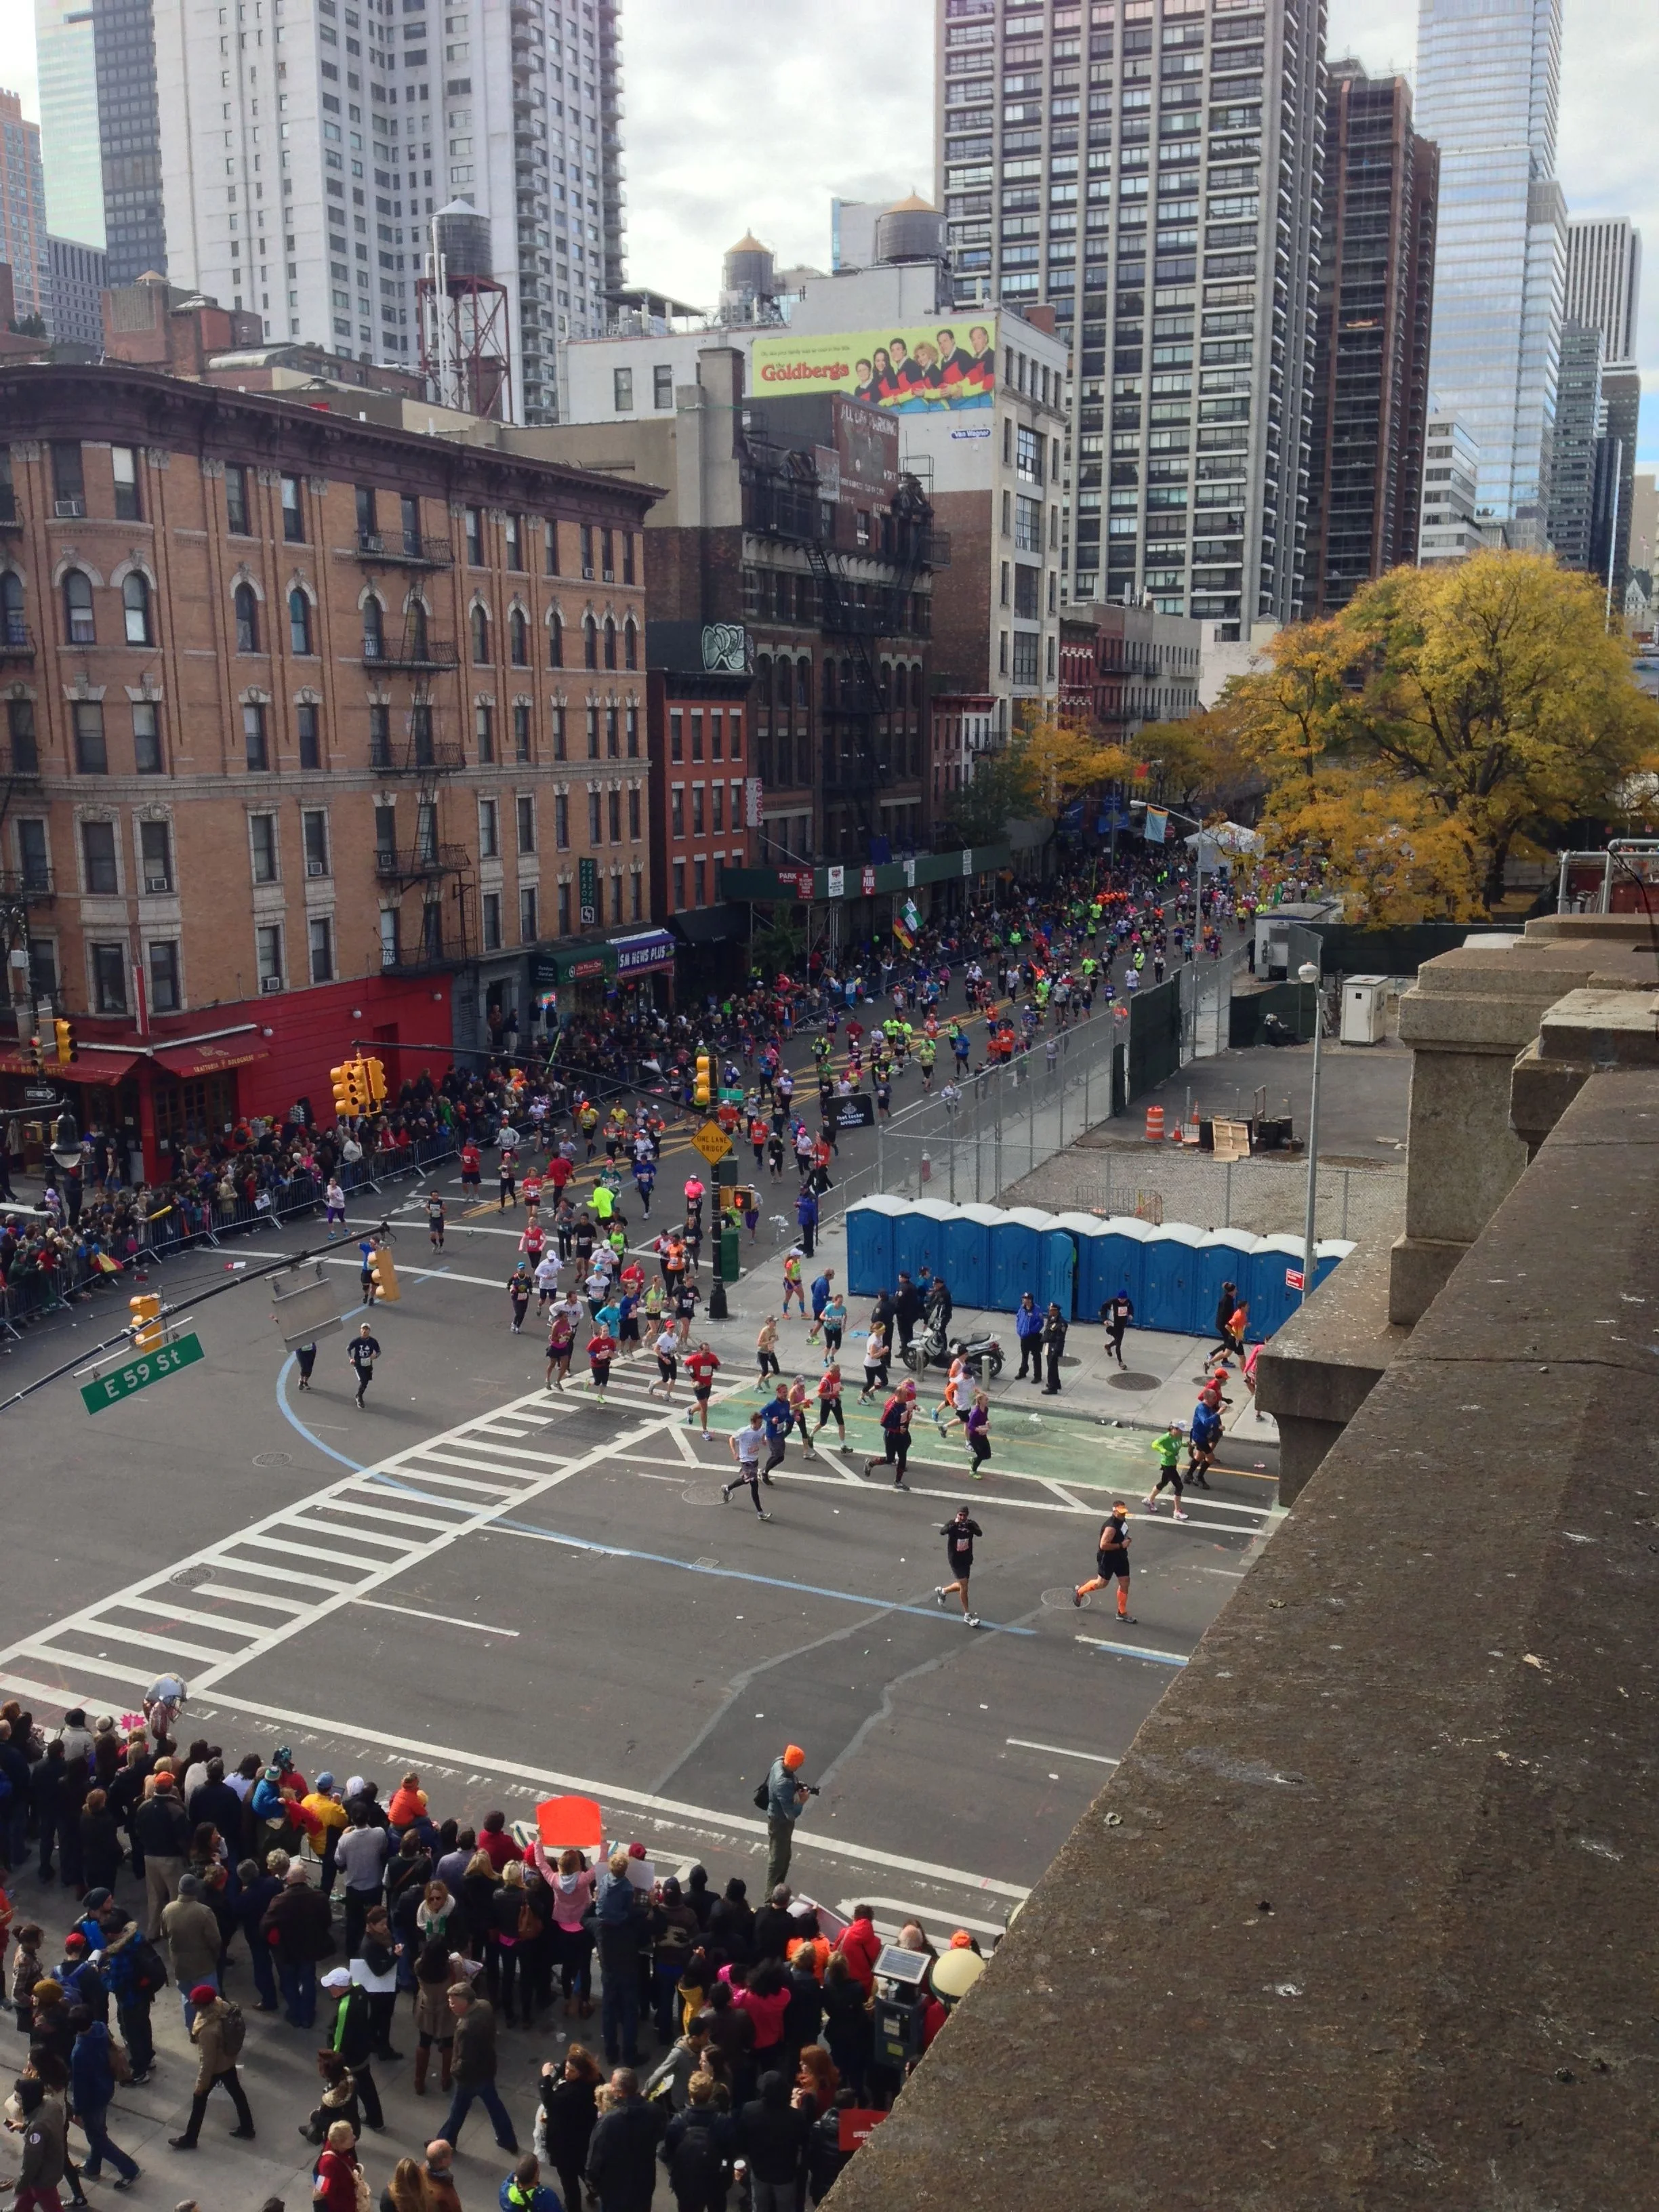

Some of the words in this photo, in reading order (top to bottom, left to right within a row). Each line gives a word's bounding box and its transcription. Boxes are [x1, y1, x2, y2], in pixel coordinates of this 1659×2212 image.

[761, 361, 850, 381] Goldbergs
[632, 949, 649, 965] NEWS
[651, 945, 665, 961] PLUS
[702, 1144, 724, 1152] BRIDGE
[712, 1136, 728, 1144] LANE
[104, 1378, 120, 1399] E
[123, 1364, 150, 1389] 59
[156, 1349, 181, 1371] St
